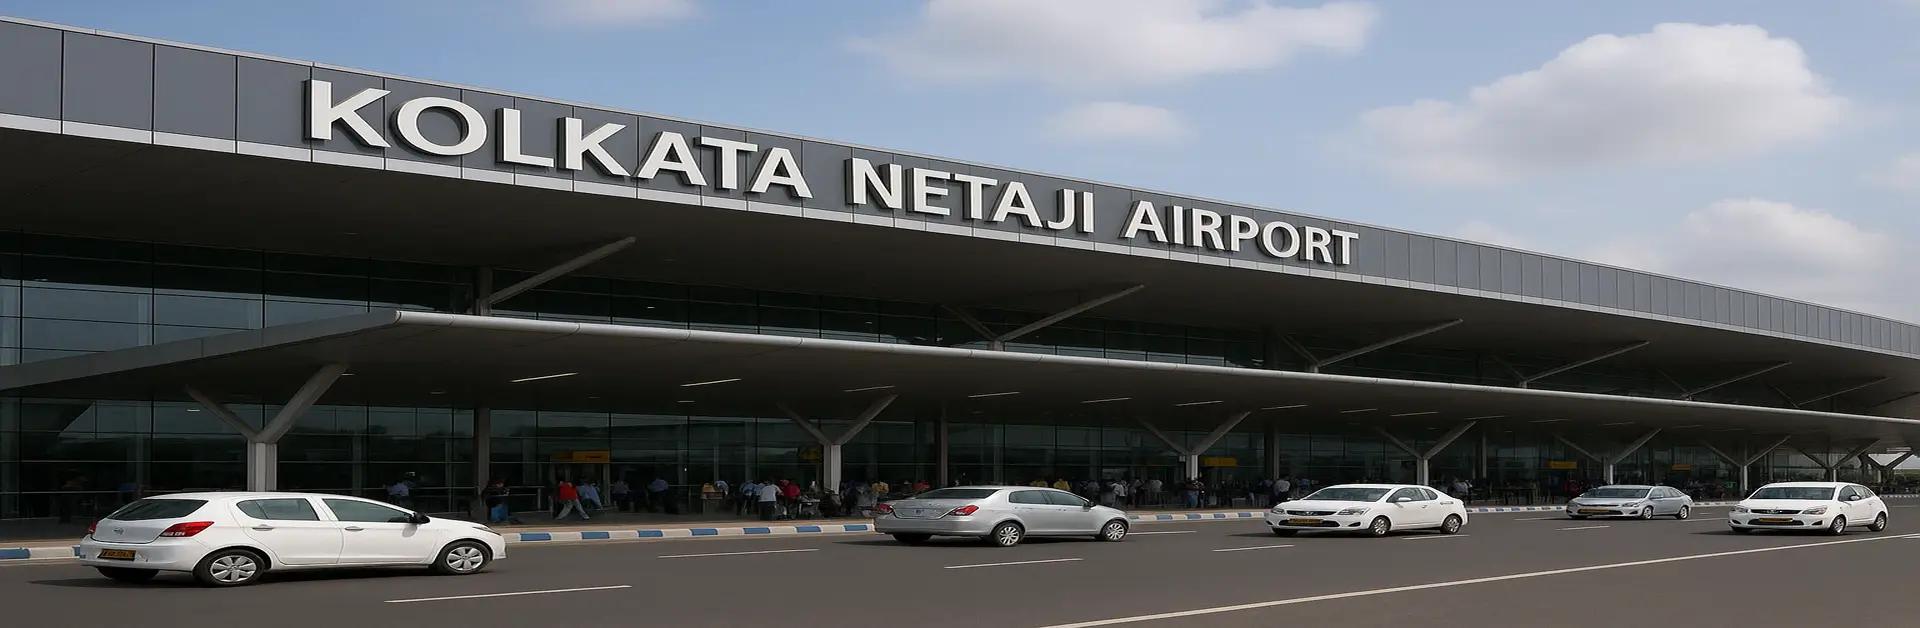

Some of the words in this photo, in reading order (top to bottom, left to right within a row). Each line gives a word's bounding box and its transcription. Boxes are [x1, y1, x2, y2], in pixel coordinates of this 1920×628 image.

[308, 79, 813, 199] KOLKATA
[849, 157, 1095, 233] NETAJI
[1123, 199, 1359, 265] AIRPORT
